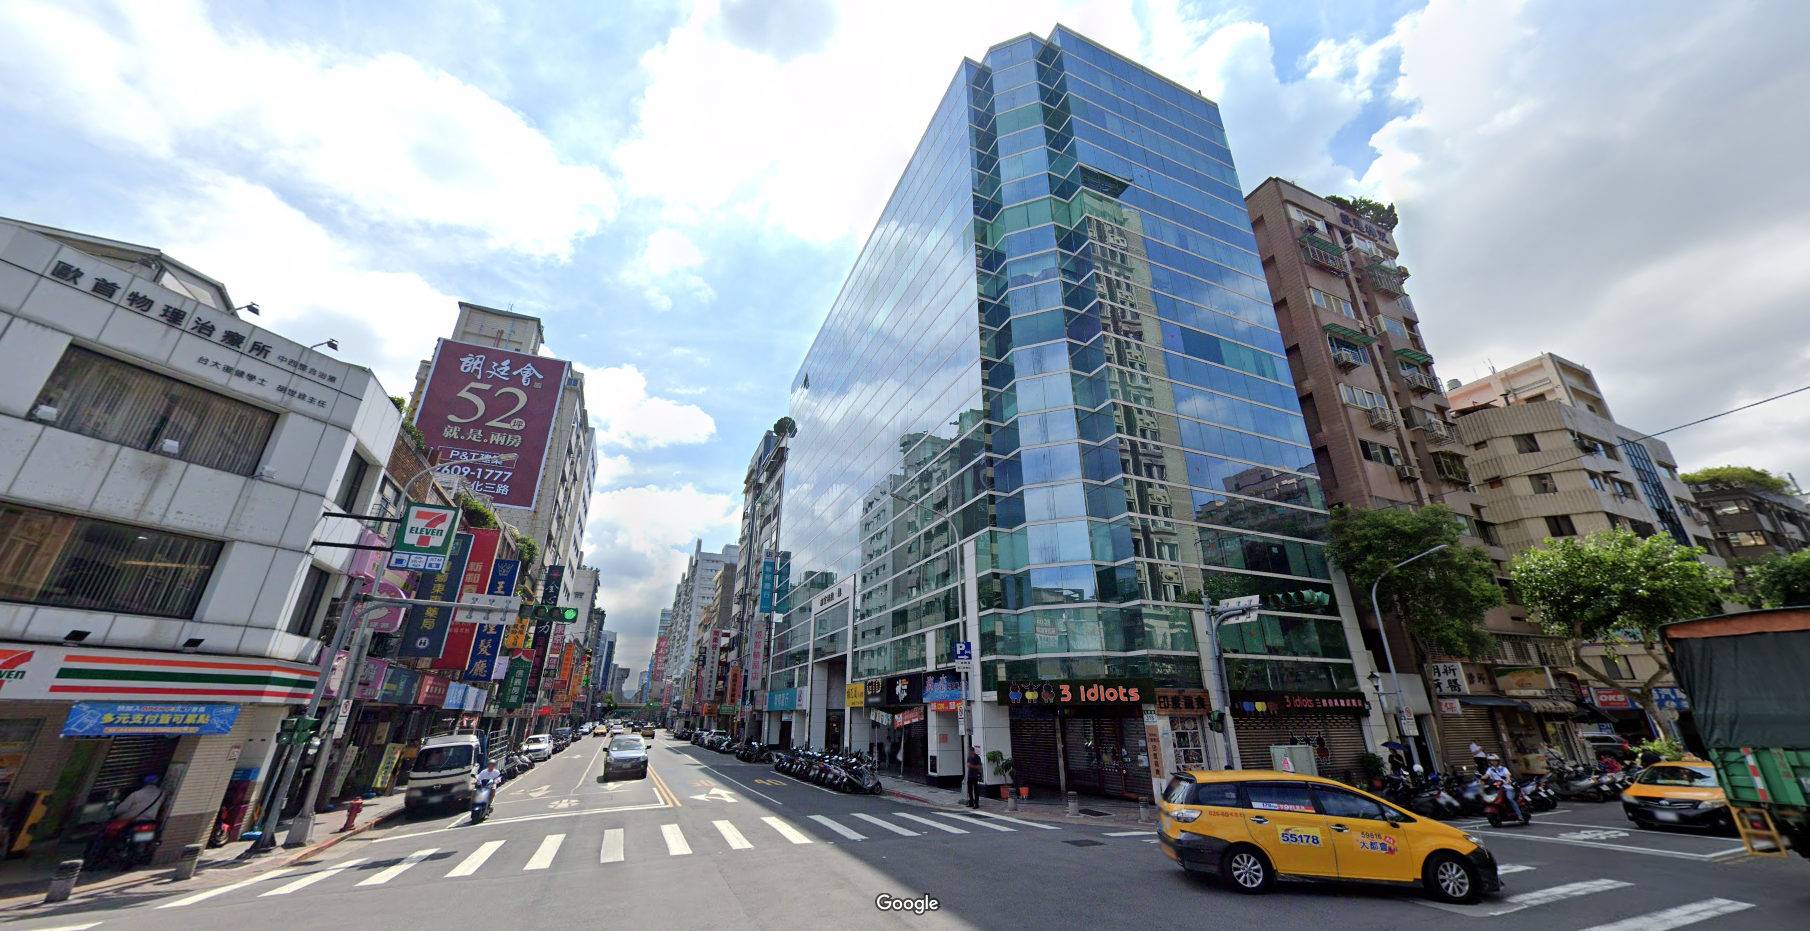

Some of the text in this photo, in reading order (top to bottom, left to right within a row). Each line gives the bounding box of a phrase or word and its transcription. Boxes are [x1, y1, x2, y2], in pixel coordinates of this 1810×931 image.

[50, 259, 274, 360] 歐首物理治療所
[447, 381, 528, 430] 52
[466, 481, 510, 496] 化三路
[762, 565, 773, 599] 聯邦銀行
[469, 580, 506, 678] 王理髮廳
[956, 643, 966, 655] P
[508, 669, 524, 703] 信義房屋
[1059, 684, 1140, 702] 3 idiots
[101, 713, 211, 726] 多元支付皆可累點
[1281, 832, 1320, 846] 55178
[1359, 840, 1389, 852] 大都會
